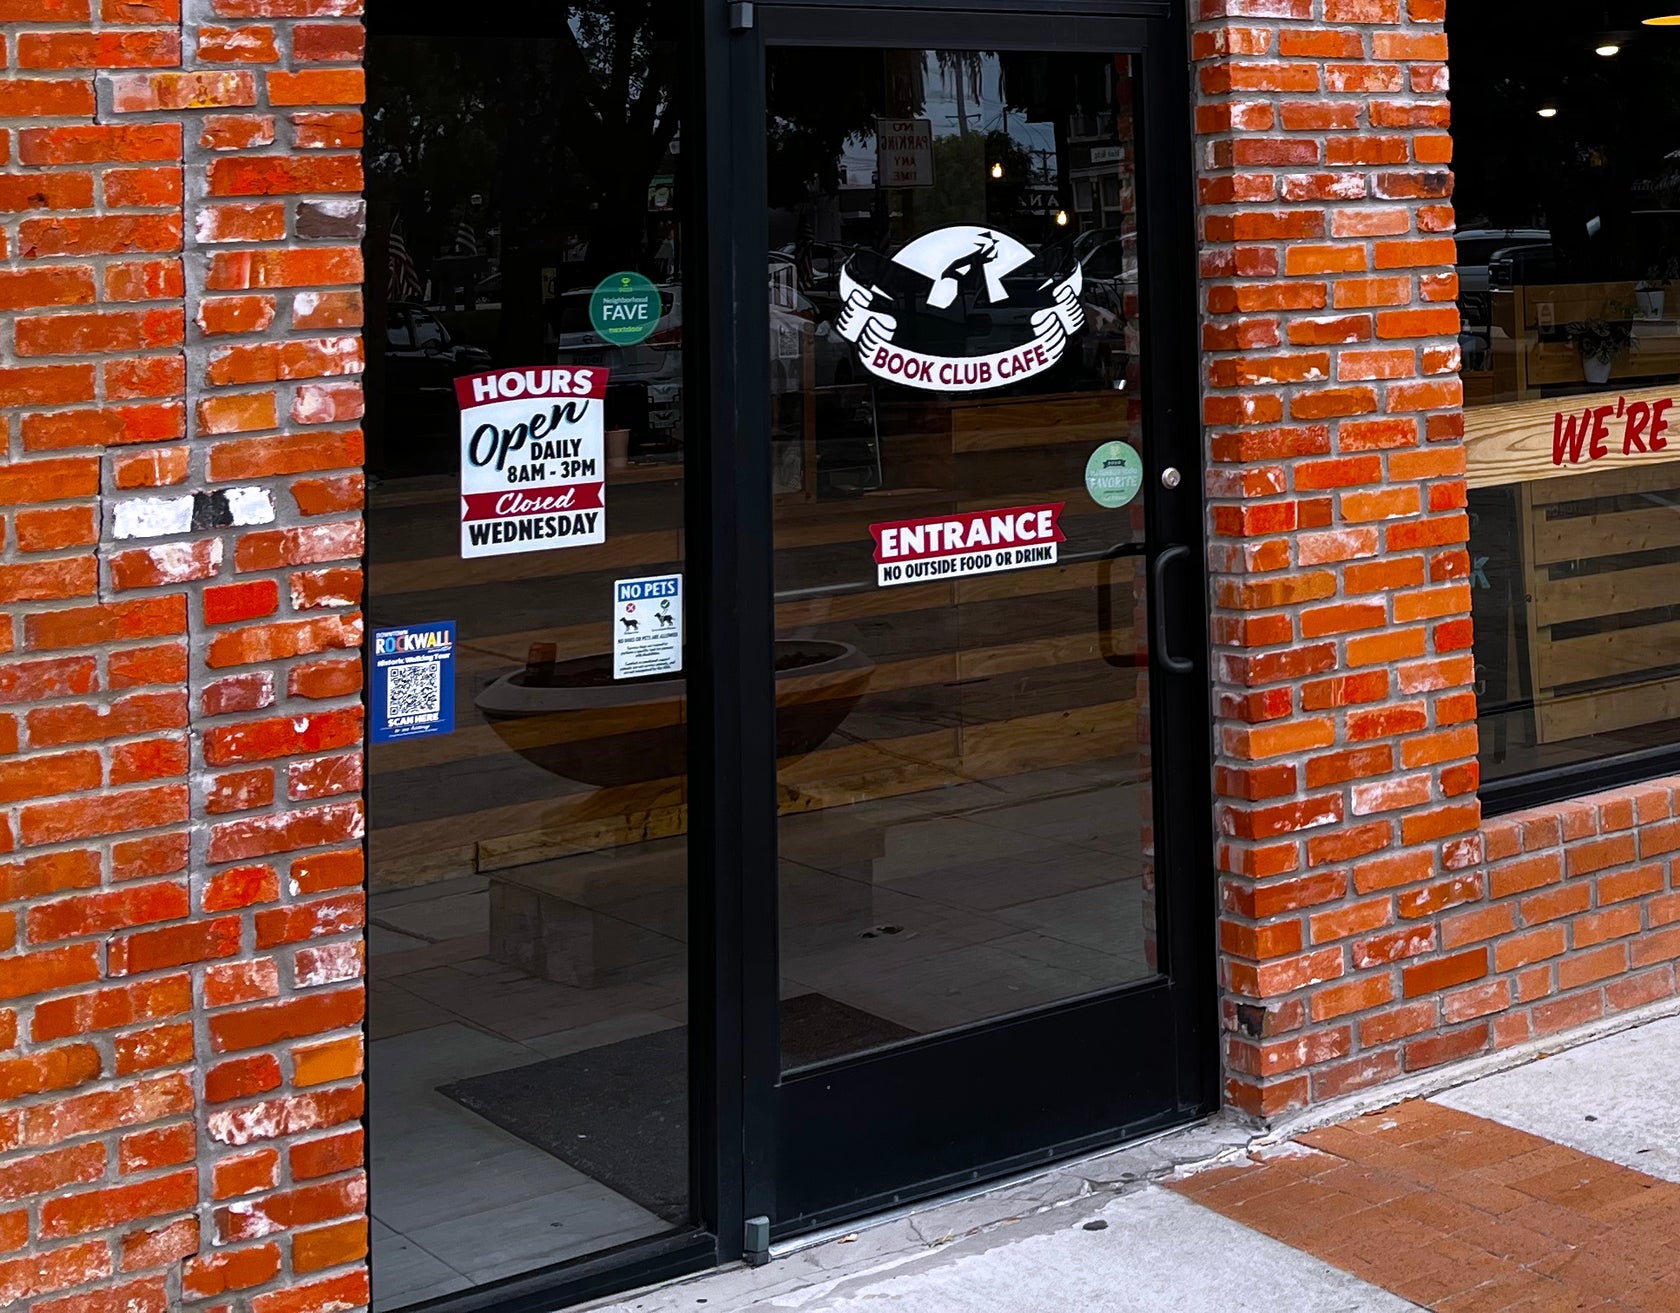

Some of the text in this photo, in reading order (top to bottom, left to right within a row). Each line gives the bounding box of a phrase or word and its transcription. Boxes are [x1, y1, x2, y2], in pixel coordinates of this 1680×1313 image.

[602, 304, 649, 321] FAVE
[872, 344, 1049, 385] BOOK CLUB CAFE
[472, 369, 594, 402] HOURS
[468, 399, 590, 472] Open
[1552, 396, 1673, 466] WE'RE
[530, 438, 582, 461] DAILY
[507, 463, 545, 483] 8AM
[560, 459, 596, 479] 3PM
[495, 487, 576, 515] Closed
[469, 512, 599, 546] WEDNESDAY
[881, 510, 1053, 558] ENTRANCE
[883, 546, 1052, 581] NO OUTSIDE FOOD OR DRINK
[621, 580, 675, 600] NO PETS
[376, 630, 453, 655] ROCKWALL
[387, 712, 439, 727] SCAN HERE
